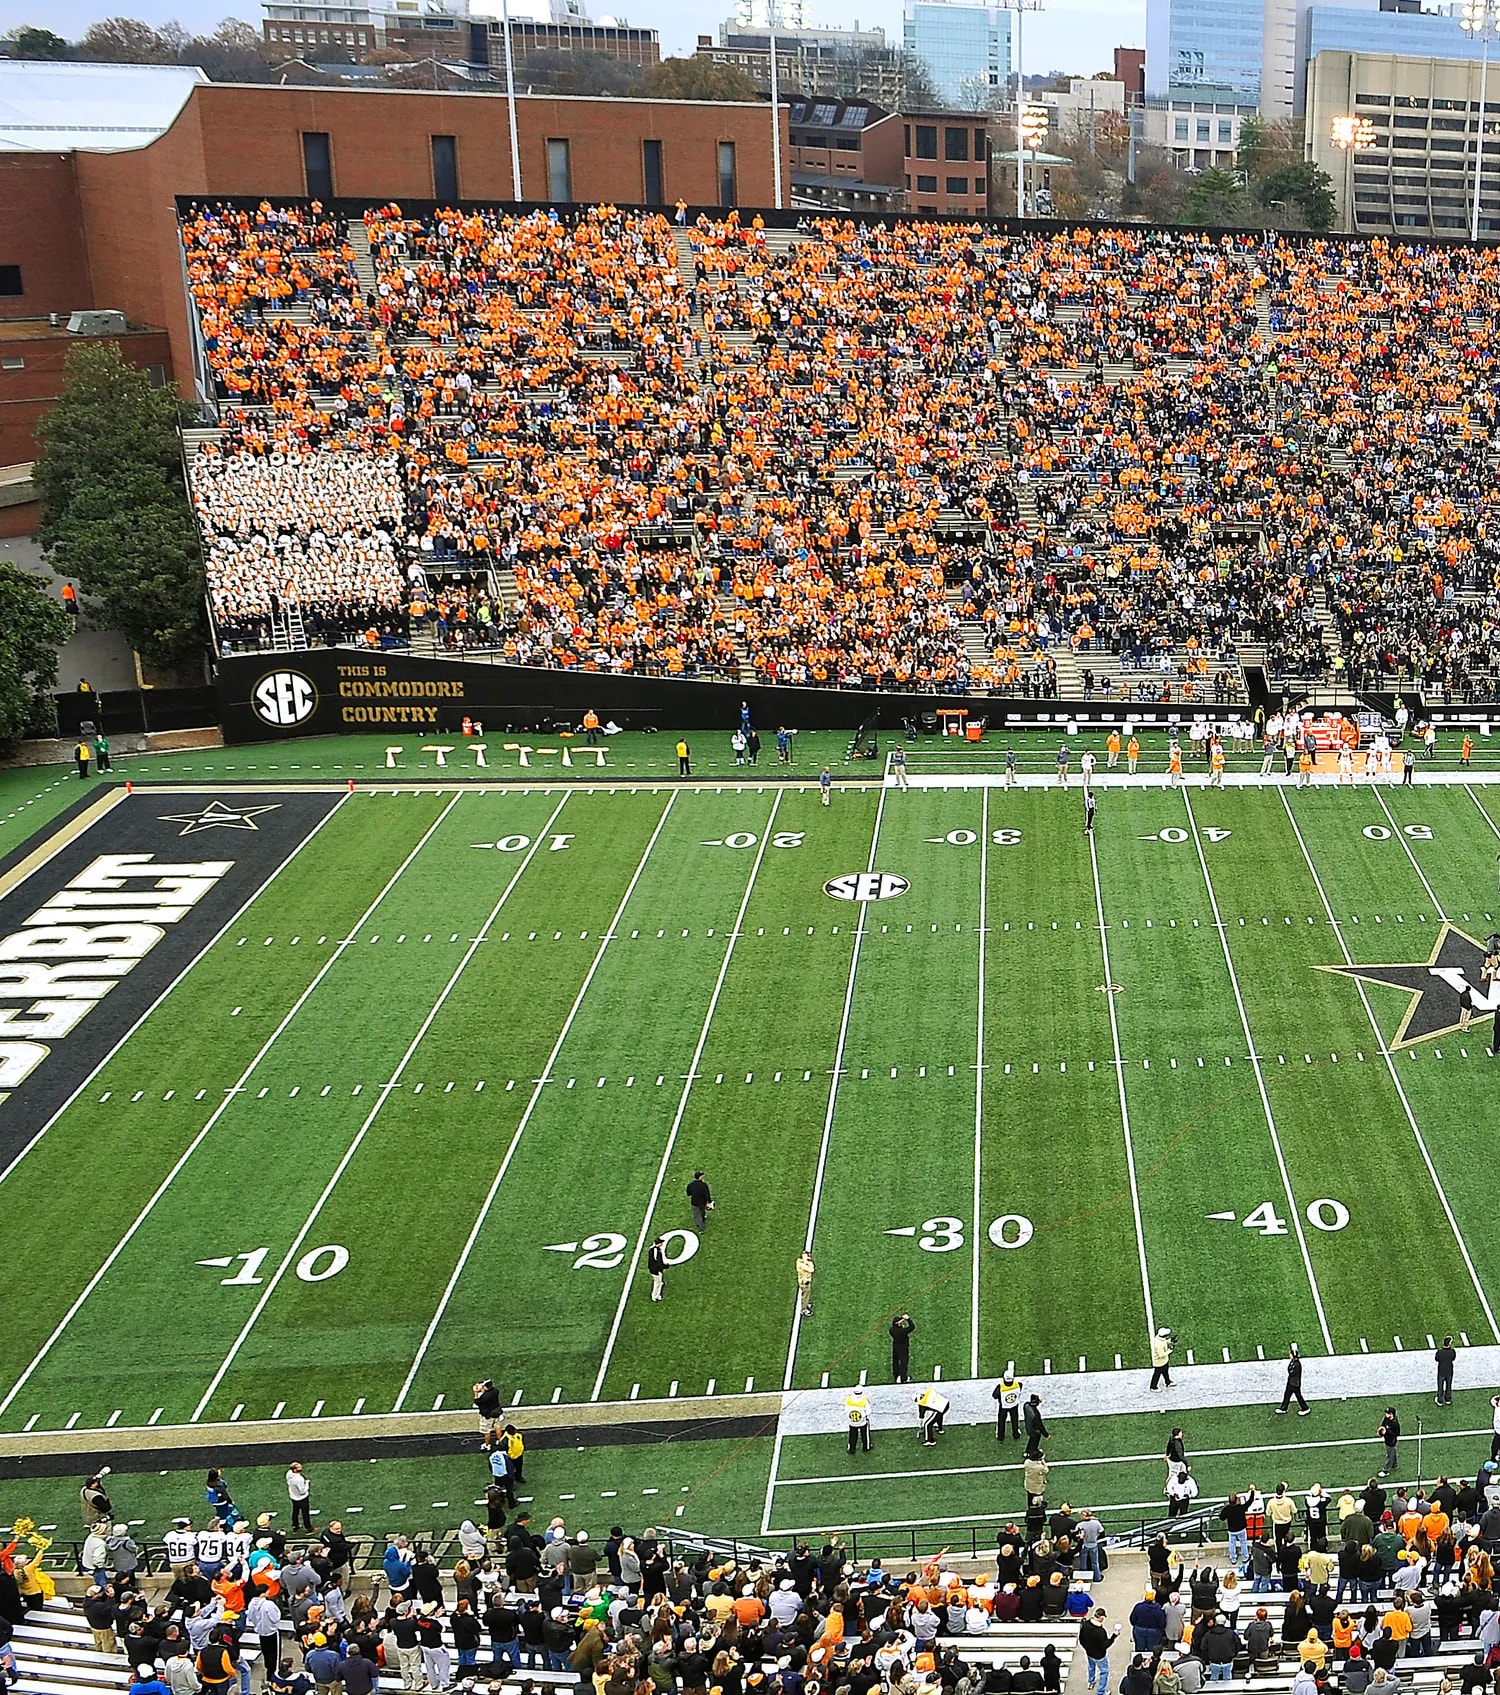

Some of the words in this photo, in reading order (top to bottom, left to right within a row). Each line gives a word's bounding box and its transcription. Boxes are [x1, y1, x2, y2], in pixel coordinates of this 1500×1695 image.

[337, 666, 369, 676] THIS
[373, 666, 386, 676] IS
[256, 673, 314, 724] SEC
[339, 682, 464, 697] COMMODORE
[342, 707, 438, 722] COUNTRY
[827, 872, 906, 900] SEC
[1241, 1198, 1350, 1232] 40
[917, 1213, 1034, 1253] 30
[219, 1244, 350, 1286] 10
[169, 1542, 187, 1557] 66
[201, 1540, 218, 1556] 75
